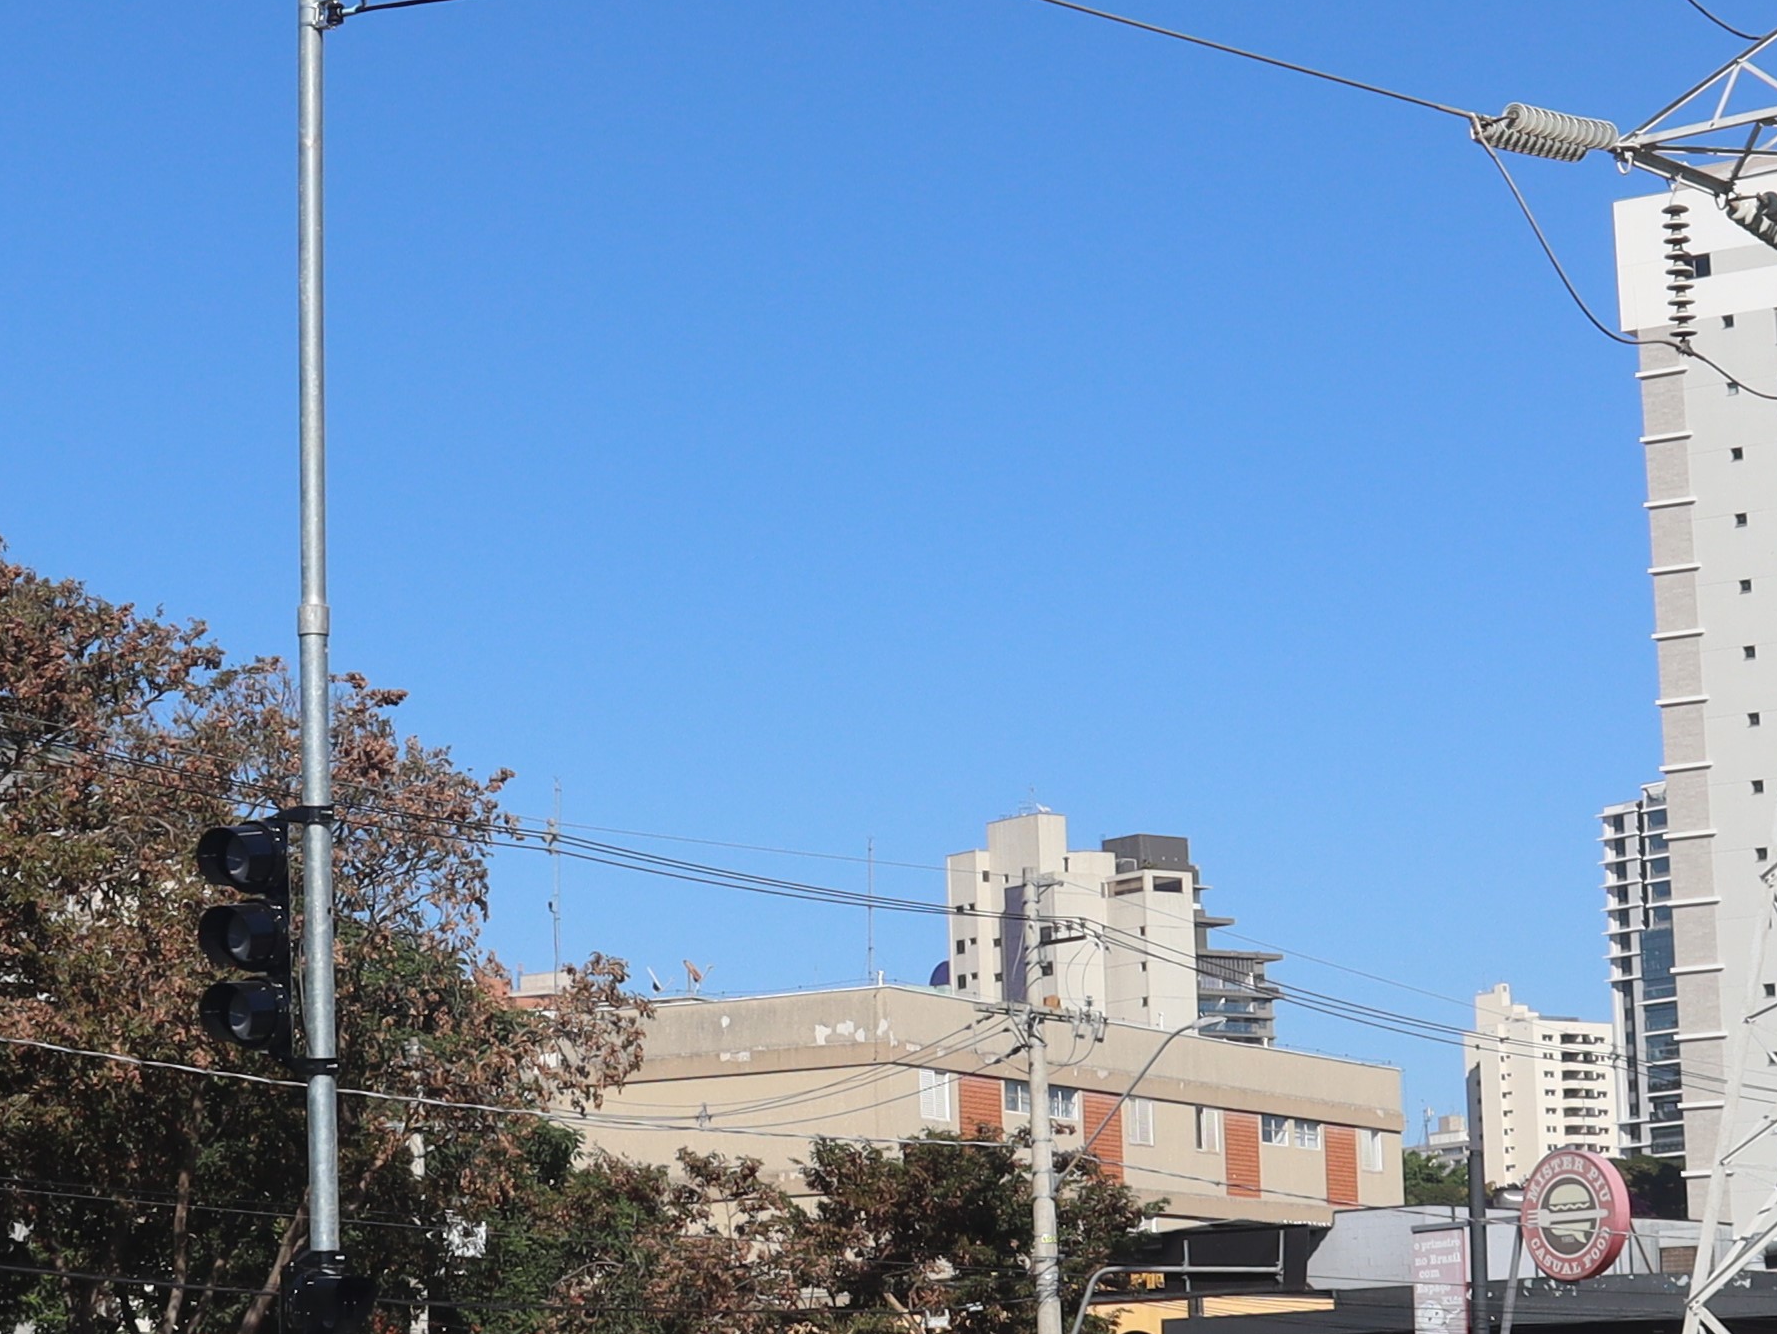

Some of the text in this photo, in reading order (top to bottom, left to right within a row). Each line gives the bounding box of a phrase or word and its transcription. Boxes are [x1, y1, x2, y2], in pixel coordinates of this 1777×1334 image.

[1527, 1155, 1612, 1203] MISTER PIU
[1421, 1238, 1461, 1252] primeiro
[1530, 1226, 1610, 1274] CASUAL FOOD
[1414, 1252, 1461, 1266] no Brasil
[1418, 1269, 1440, 1278] com
